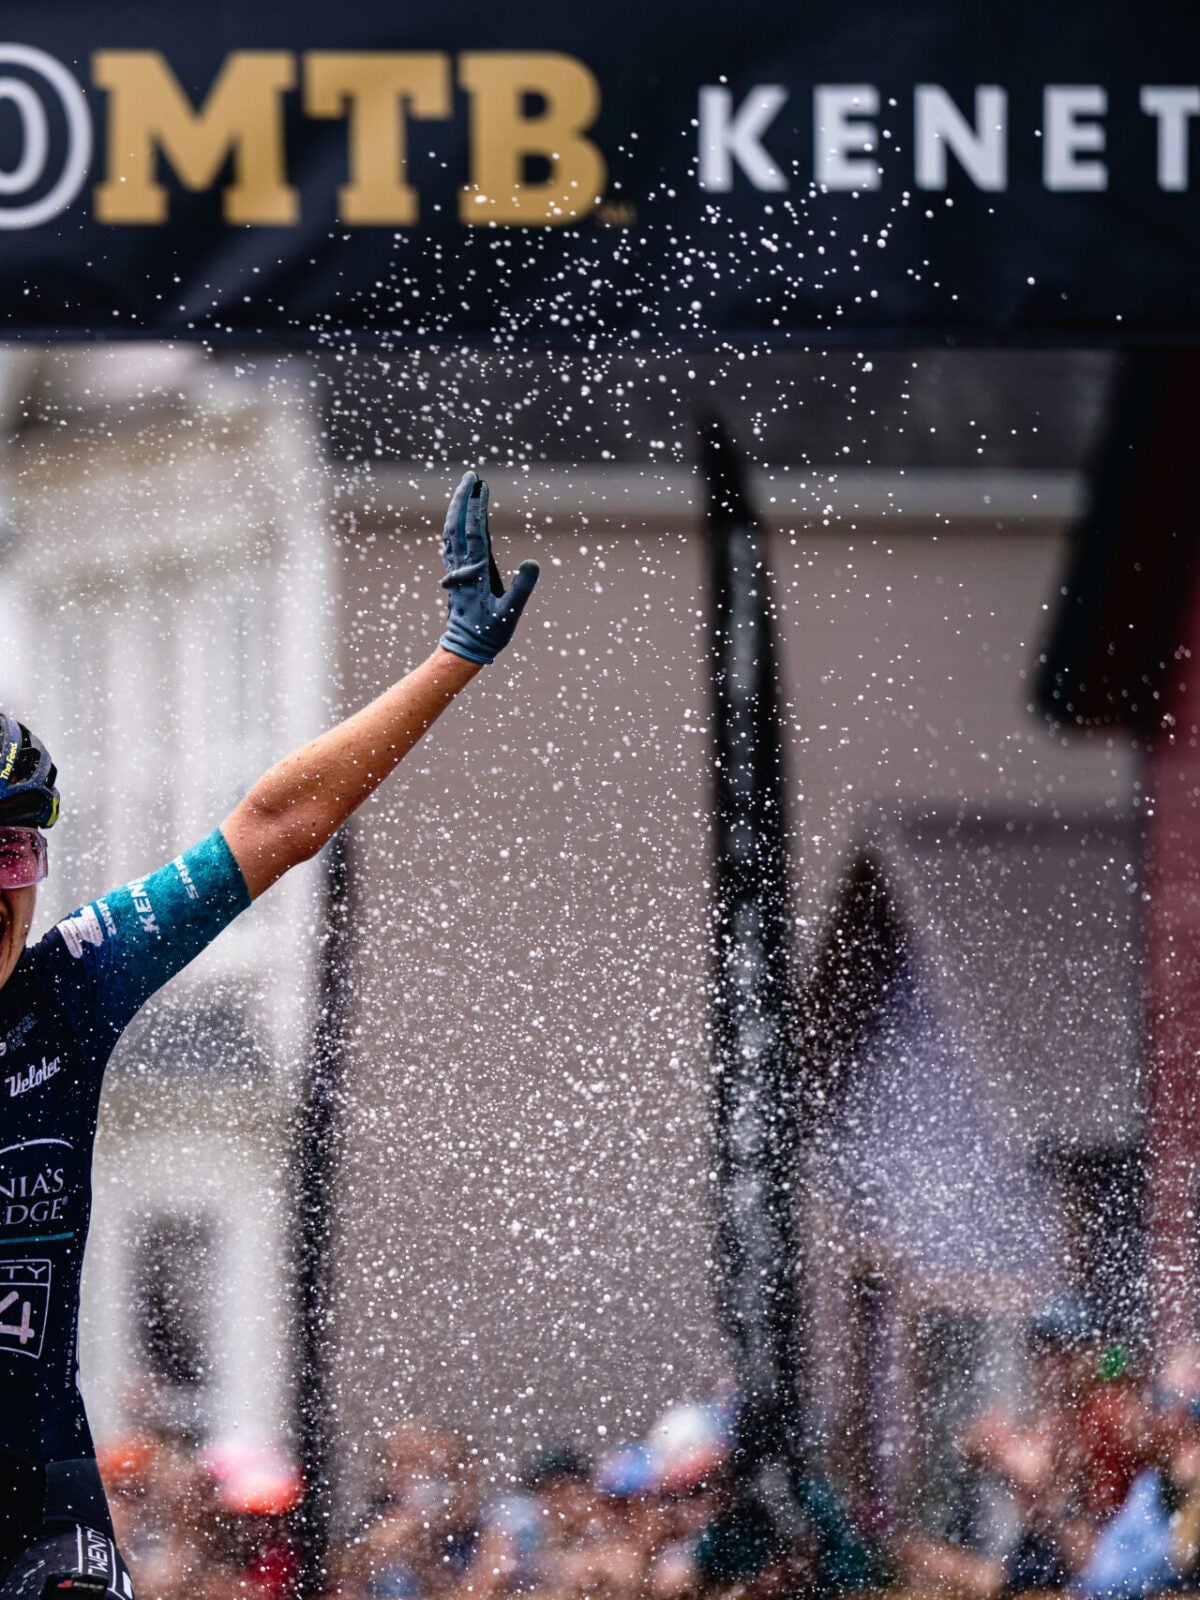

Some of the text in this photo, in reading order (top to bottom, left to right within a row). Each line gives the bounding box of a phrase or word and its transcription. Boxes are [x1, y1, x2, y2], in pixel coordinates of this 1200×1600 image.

[92, 51, 606, 226] MTB
[698, 84, 1200, 193] KENET
[127, 873, 160, 932] KEN
